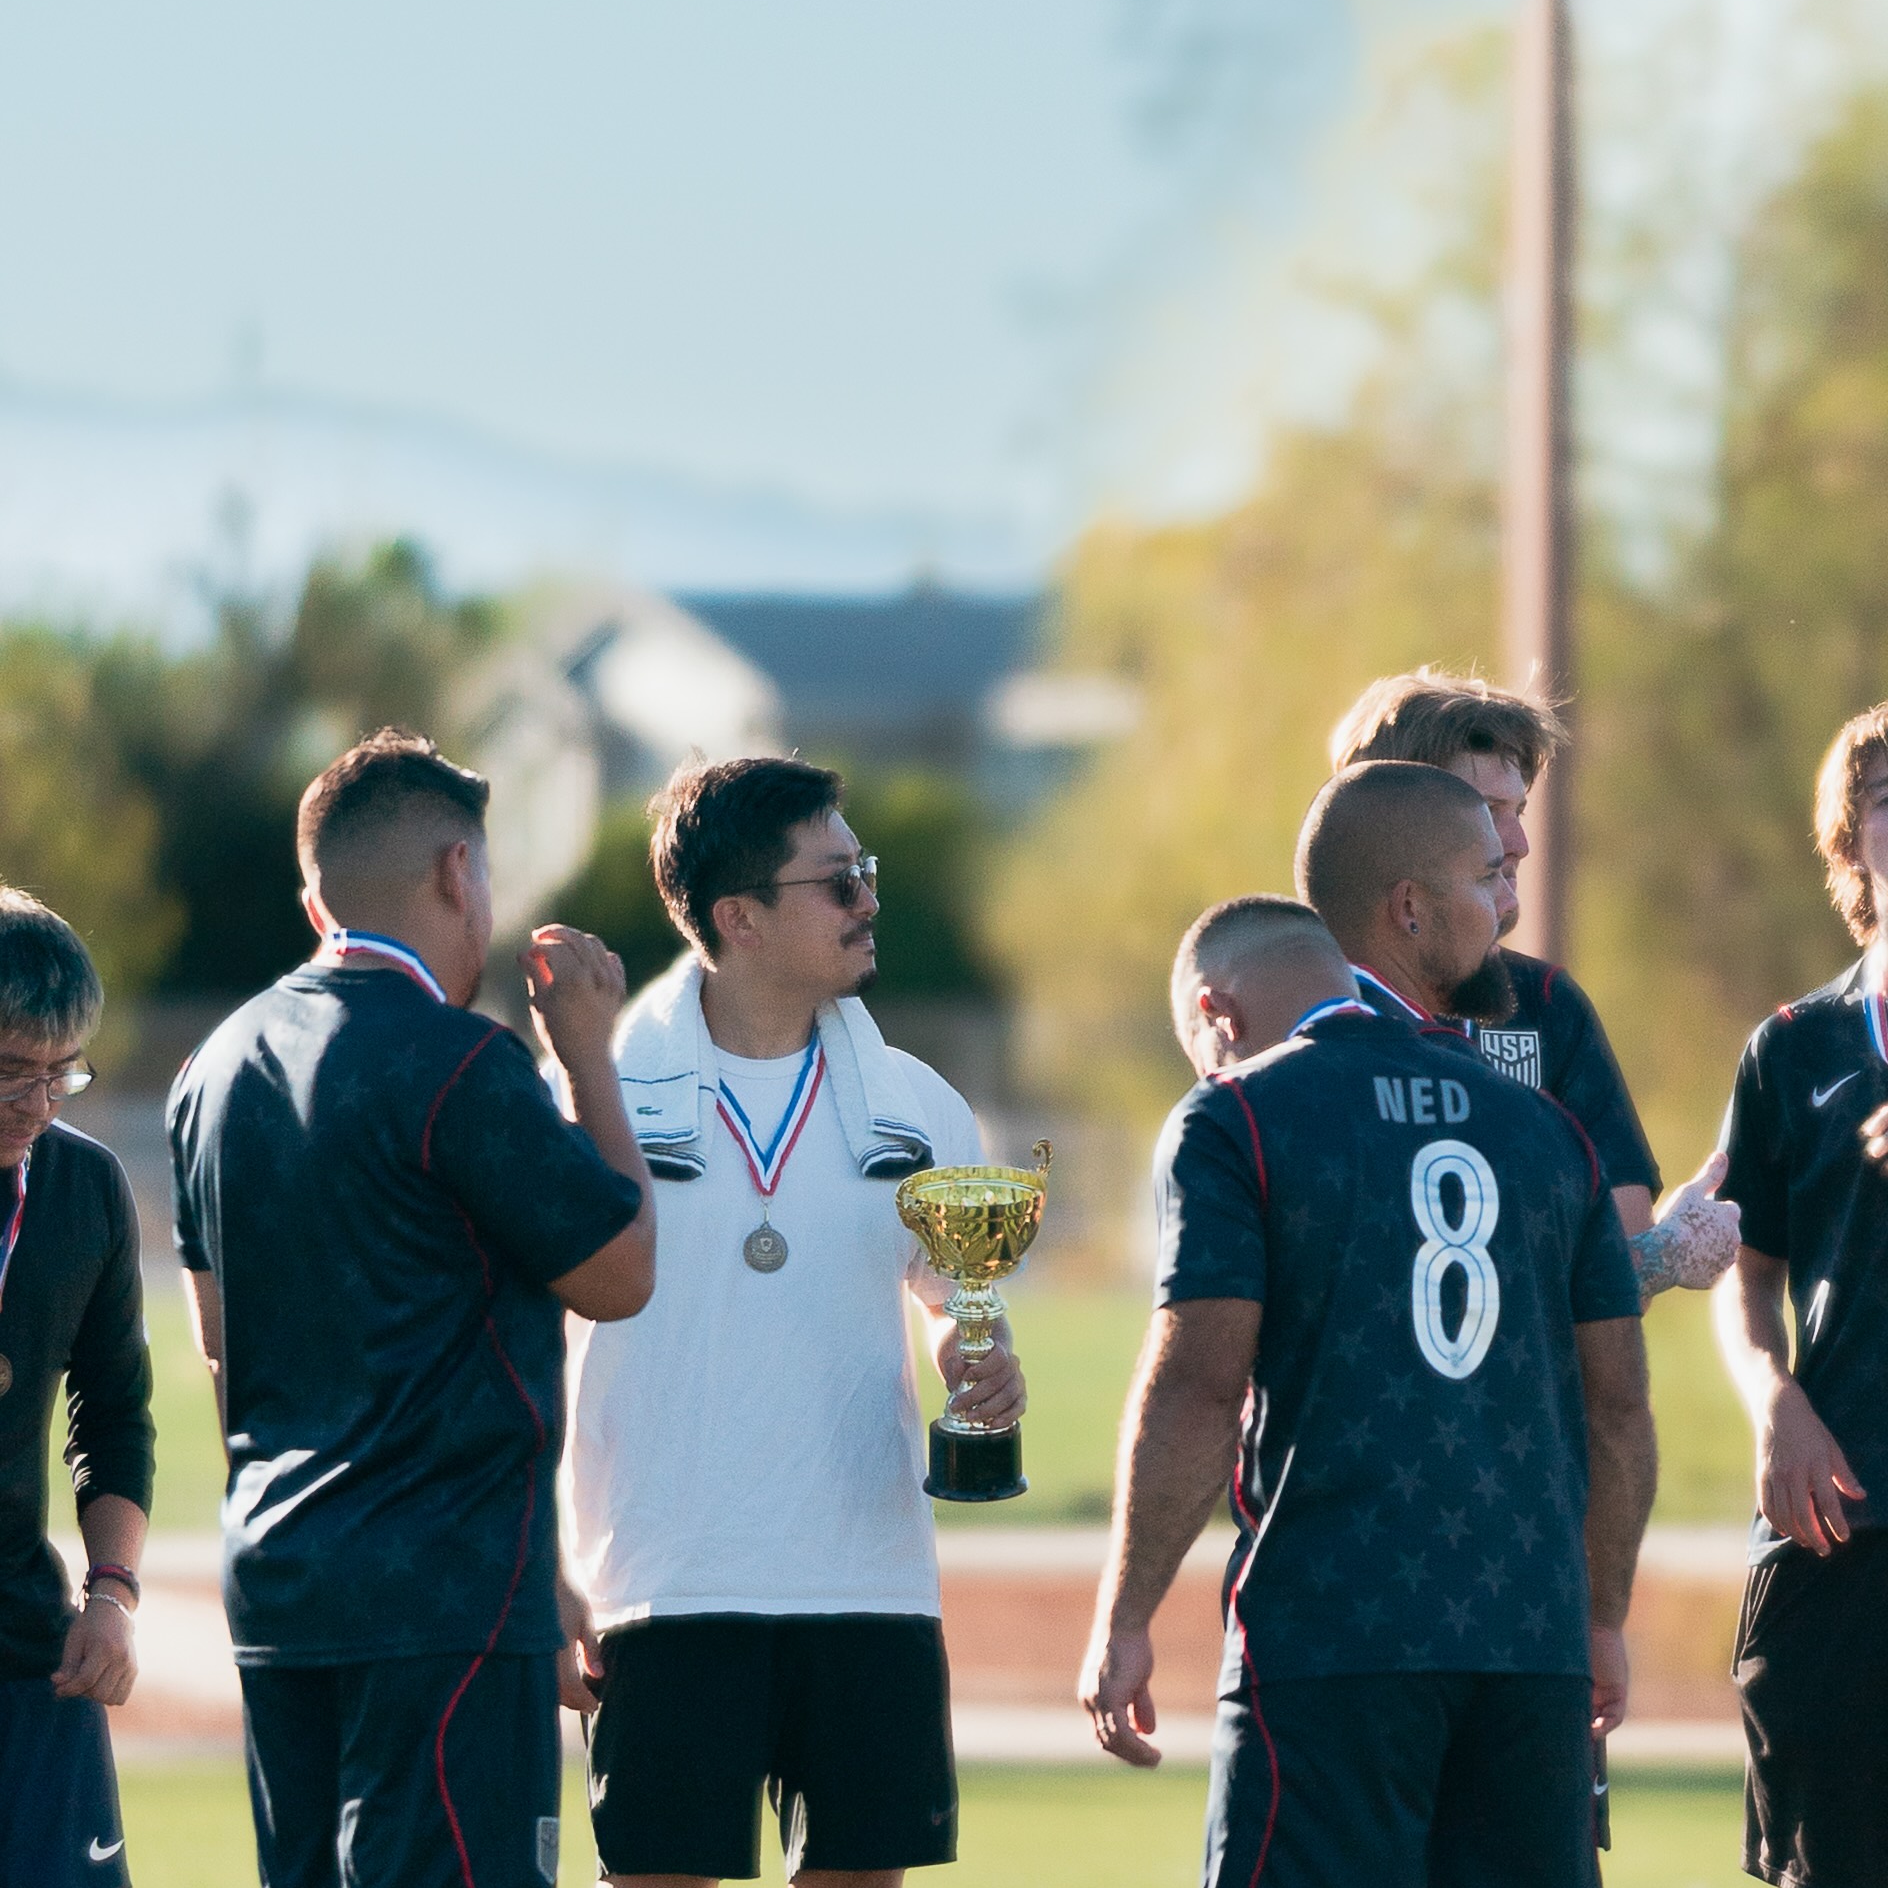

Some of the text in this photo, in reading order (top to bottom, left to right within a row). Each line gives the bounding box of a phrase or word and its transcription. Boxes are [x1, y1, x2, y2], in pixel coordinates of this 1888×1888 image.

[1485, 1033, 1535, 1062] USA
[1373, 1076, 1471, 1125] NED
[1411, 1139, 1499, 1379] 8
